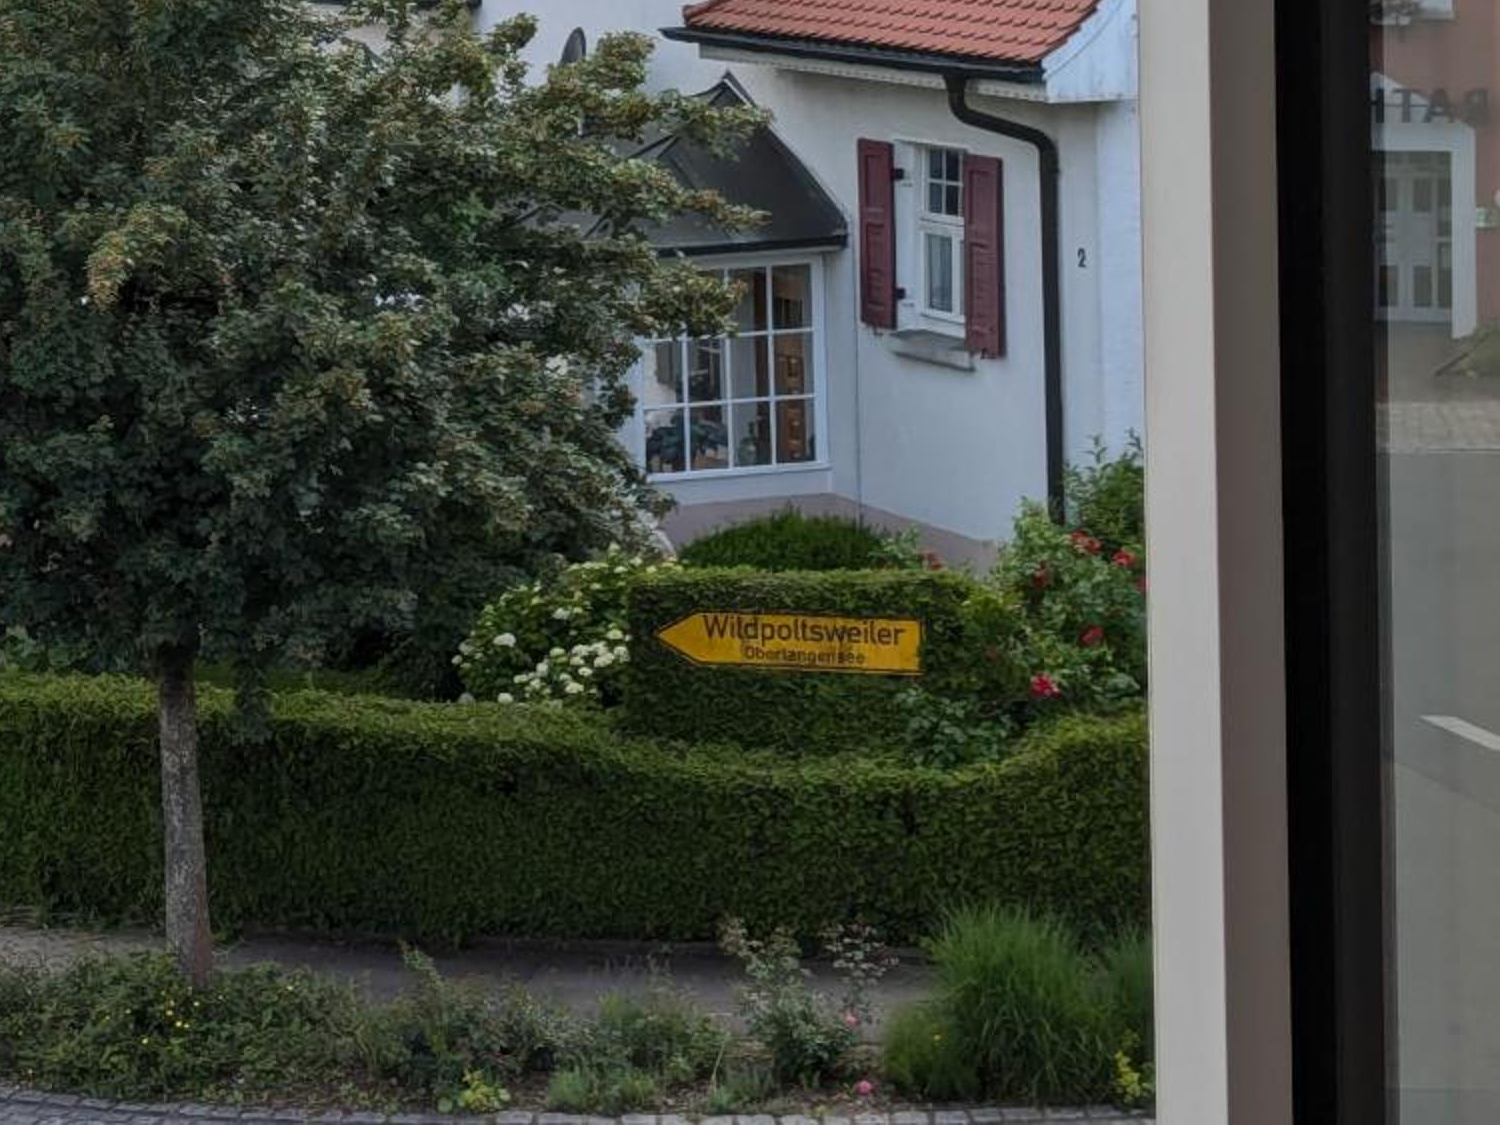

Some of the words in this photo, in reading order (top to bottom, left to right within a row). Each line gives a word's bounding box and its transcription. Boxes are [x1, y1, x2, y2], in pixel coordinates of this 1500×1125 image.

[1077, 247, 1087, 268] 2
[703, 614, 906, 647] Wildpoltsweiler
[743, 645, 867, 665] Oberlangensee
